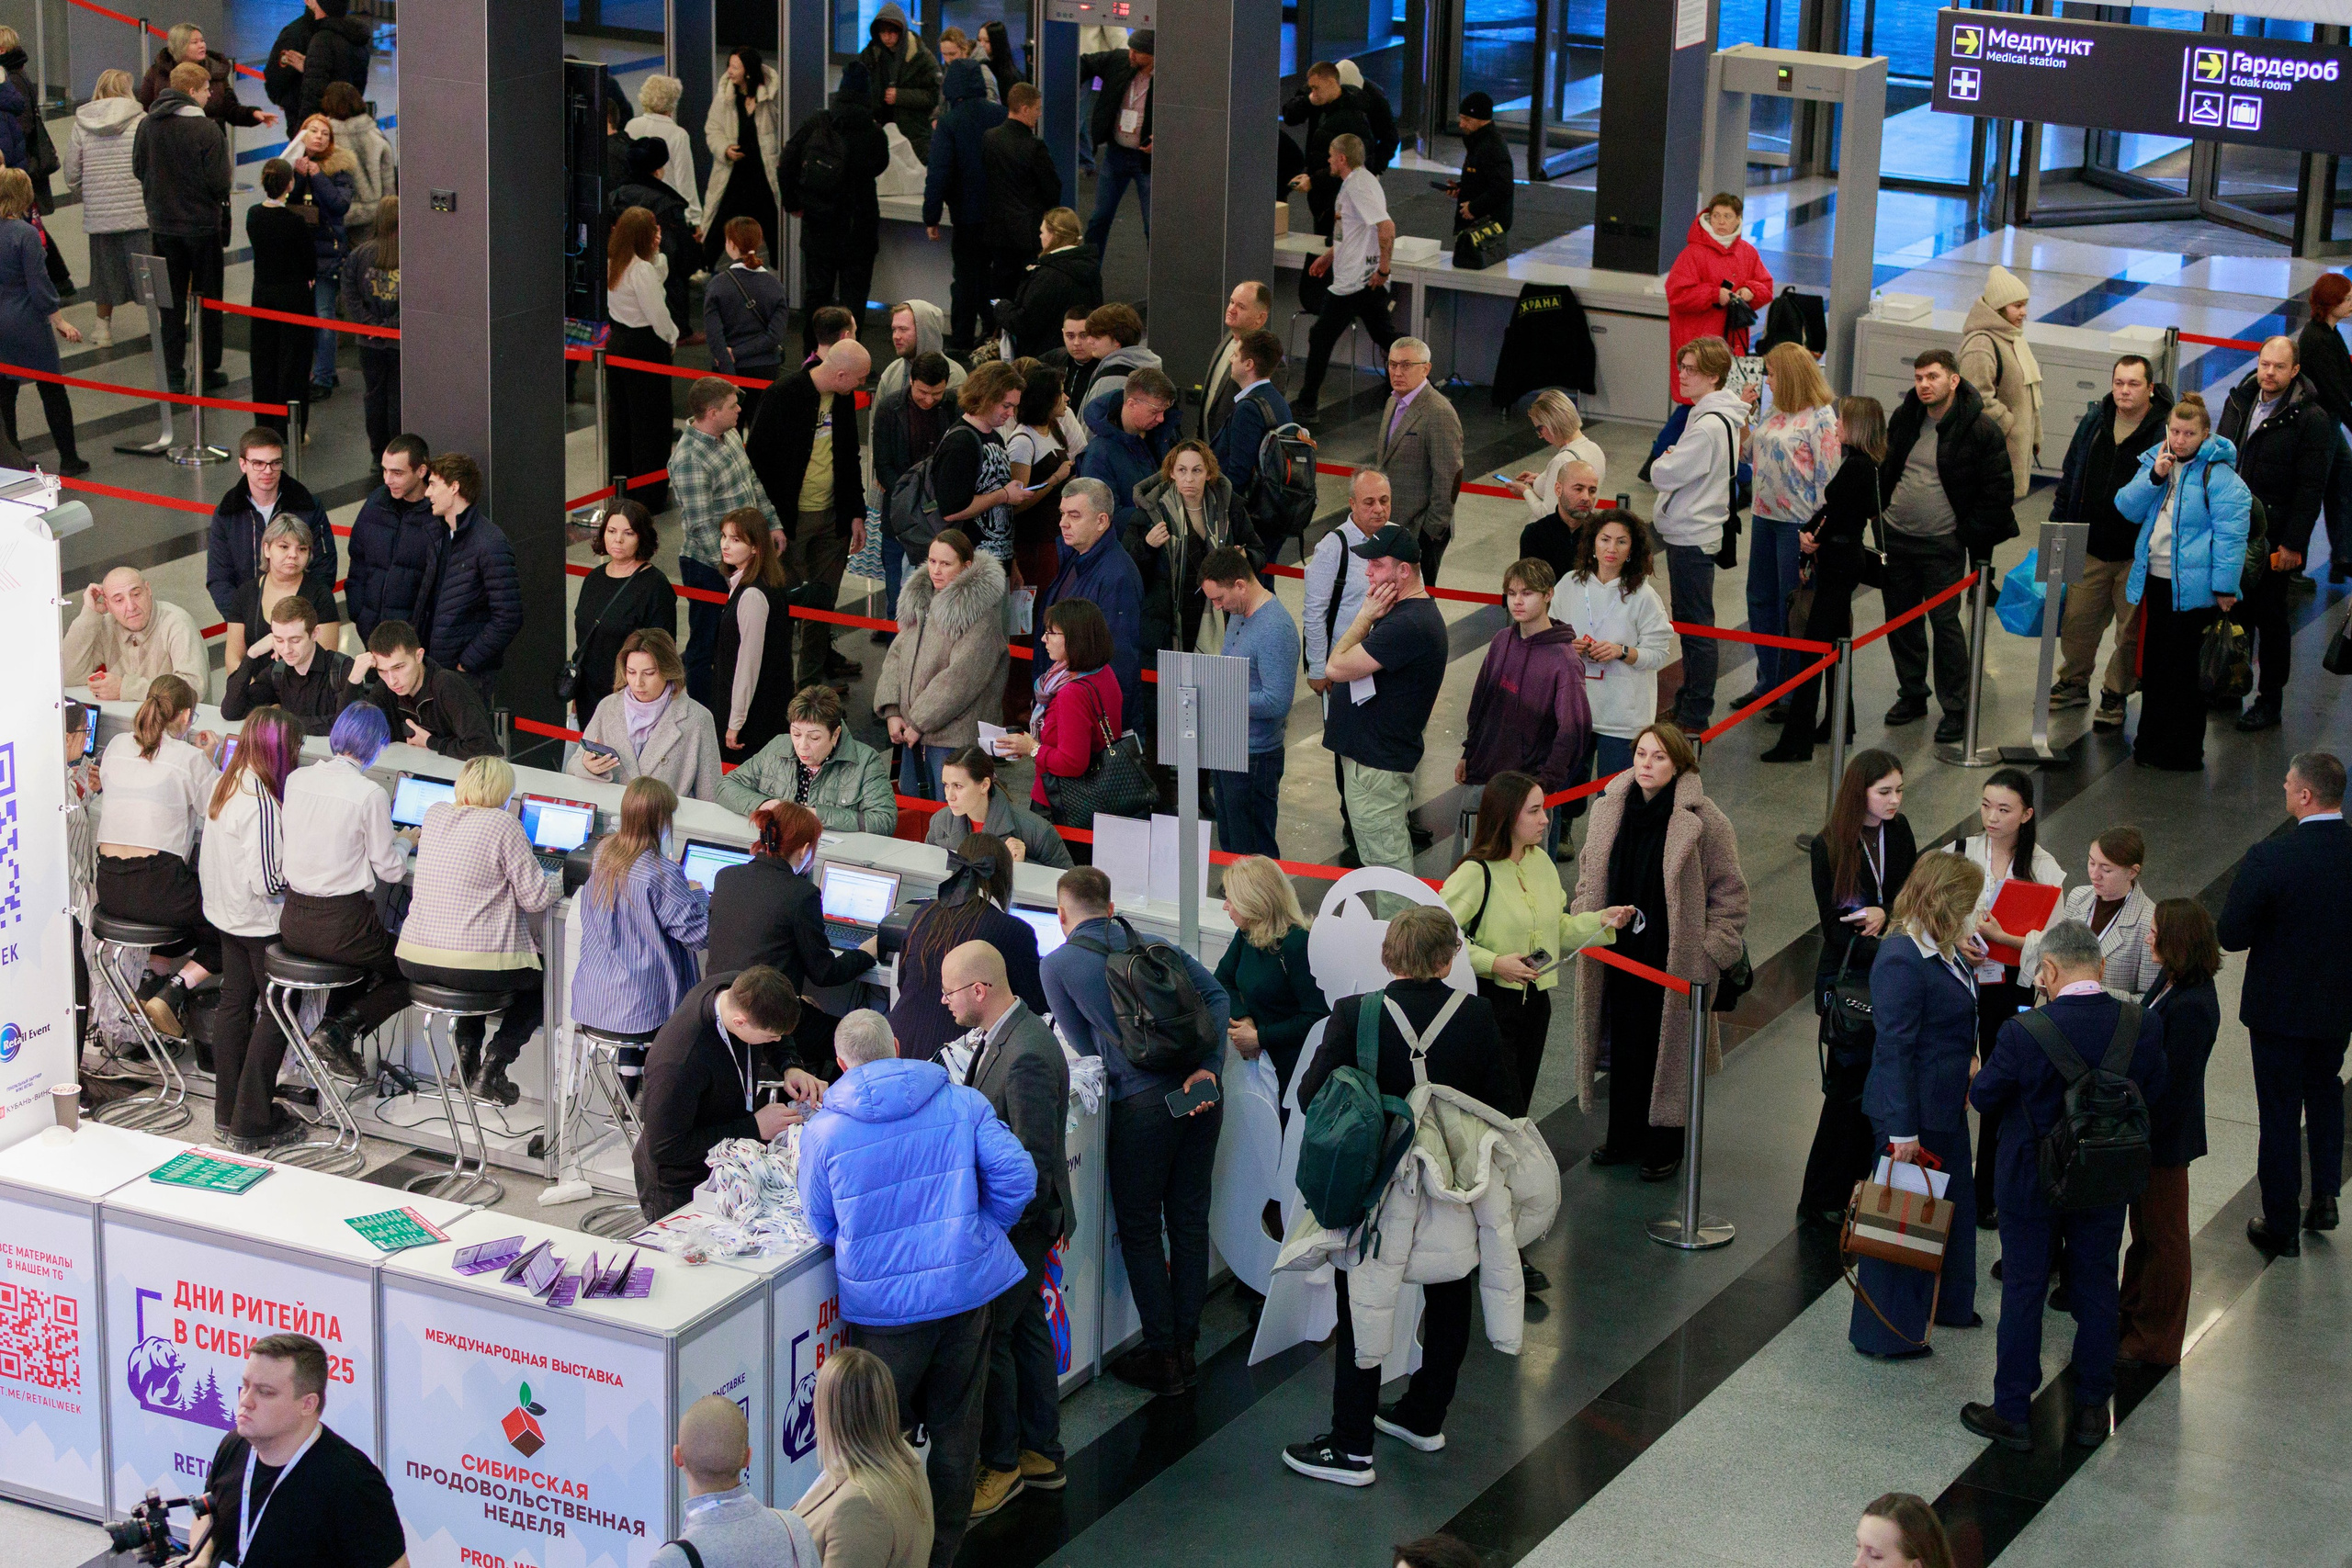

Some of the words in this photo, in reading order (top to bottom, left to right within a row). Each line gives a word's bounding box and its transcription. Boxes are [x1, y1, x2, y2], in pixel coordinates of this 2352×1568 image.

[1988, 28, 2094, 57] Медпункт
[1986, 51, 2028, 66] Medical
[2029, 55, 2066, 69] station
[2232, 52, 2339, 82] Гардероб
[2229, 75, 2261, 89] Cloak
[2262, 79, 2292, 92] room
[29, 1022, 51, 1041] Event
[6, 1258, 13, 1268] В
[15, 1259, 50, 1278] НАШЕМ
[52, 1269, 63, 1280] TG
[16, 1247, 73, 1269] МАТЕРИАЛЫ
[174, 1280, 224, 1314] ДНИ
[232, 1292, 343, 1342] РИТЕЙЛА
[817, 1293, 839, 1335] ДН
[174, 1318, 188, 1344] В
[195, 1323, 256, 1359] СИБИ
[328, 1355, 355, 1384] 25
[425, 1328, 548, 1369] МЕЖДУНАРОДНАЯ
[551, 1359, 624, 1388] ВЫСТАВКА
[817, 1342, 826, 1370] В
[0, 1386, 82, 1415] T.ME/RETAILWEEK
[461, 1453, 589, 1501] СИБИРСКАЯ
[406, 1461, 646, 1538] ПРОДОВОЛЬСТВЕННАЯ
[484, 1503, 565, 1539] НЕДЕЛЯ
